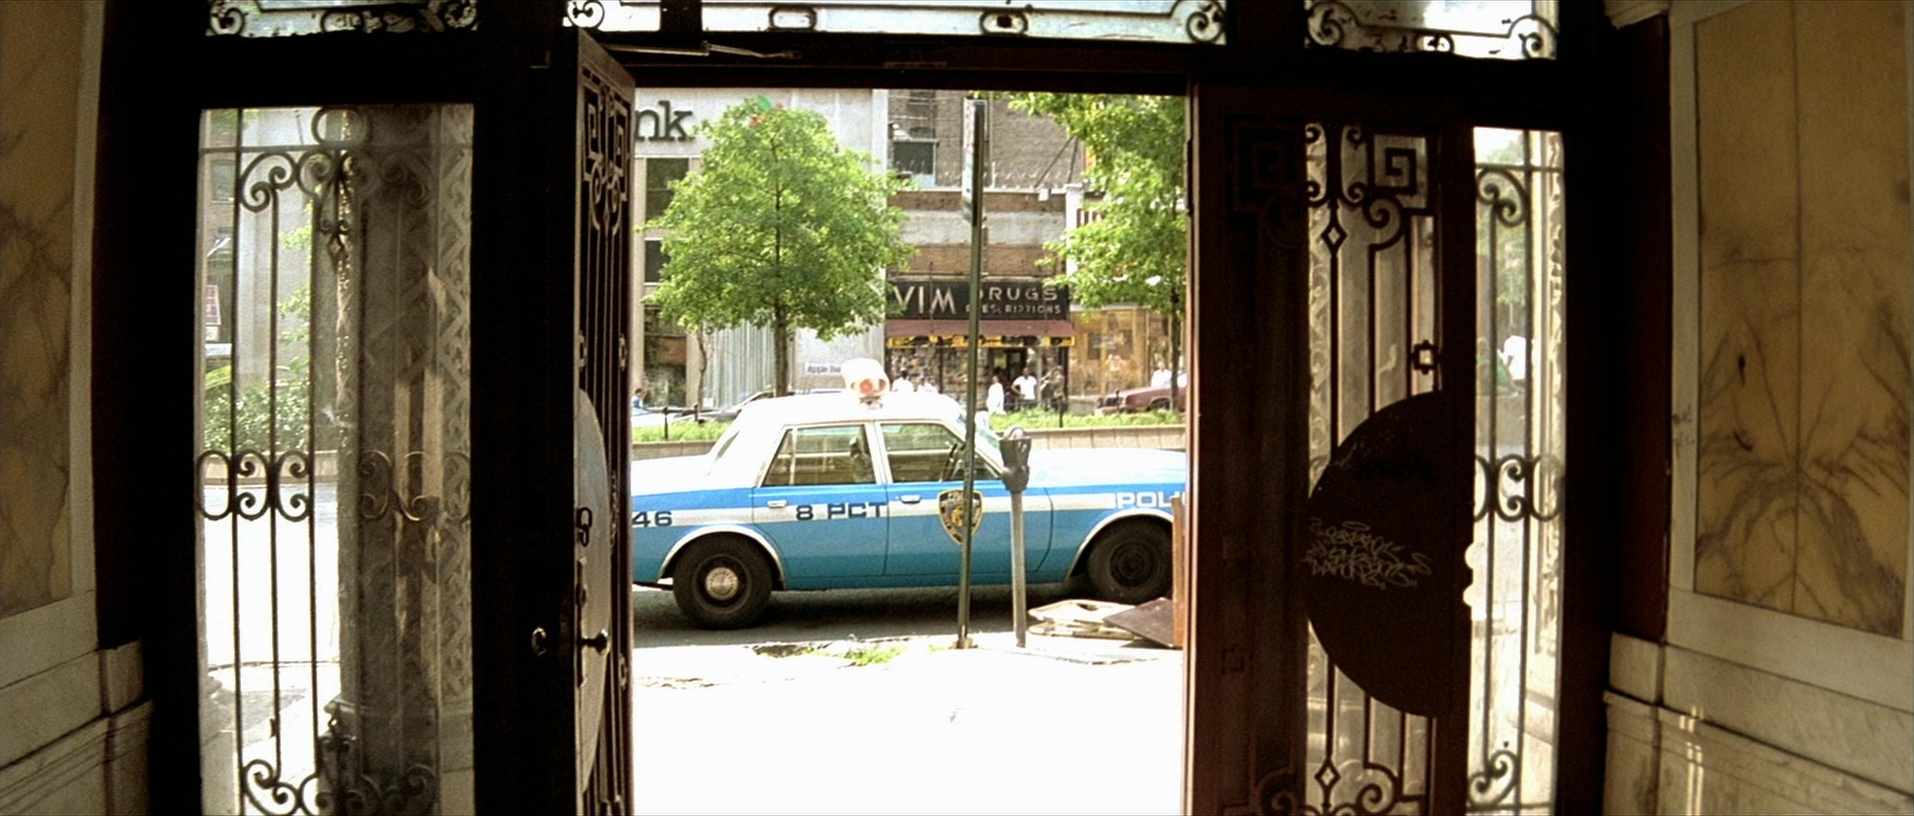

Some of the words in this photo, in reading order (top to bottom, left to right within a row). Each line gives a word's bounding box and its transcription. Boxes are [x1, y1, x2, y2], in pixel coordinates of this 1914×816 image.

[893, 285, 957, 315] VIM
[979, 286, 1058, 301] RUGS
[965, 303, 1062, 314] PESCRIPTIONS
[632, 510, 673, 527] 46
[796, 505, 814, 521] 8
[827, 502, 888, 520] PCT
